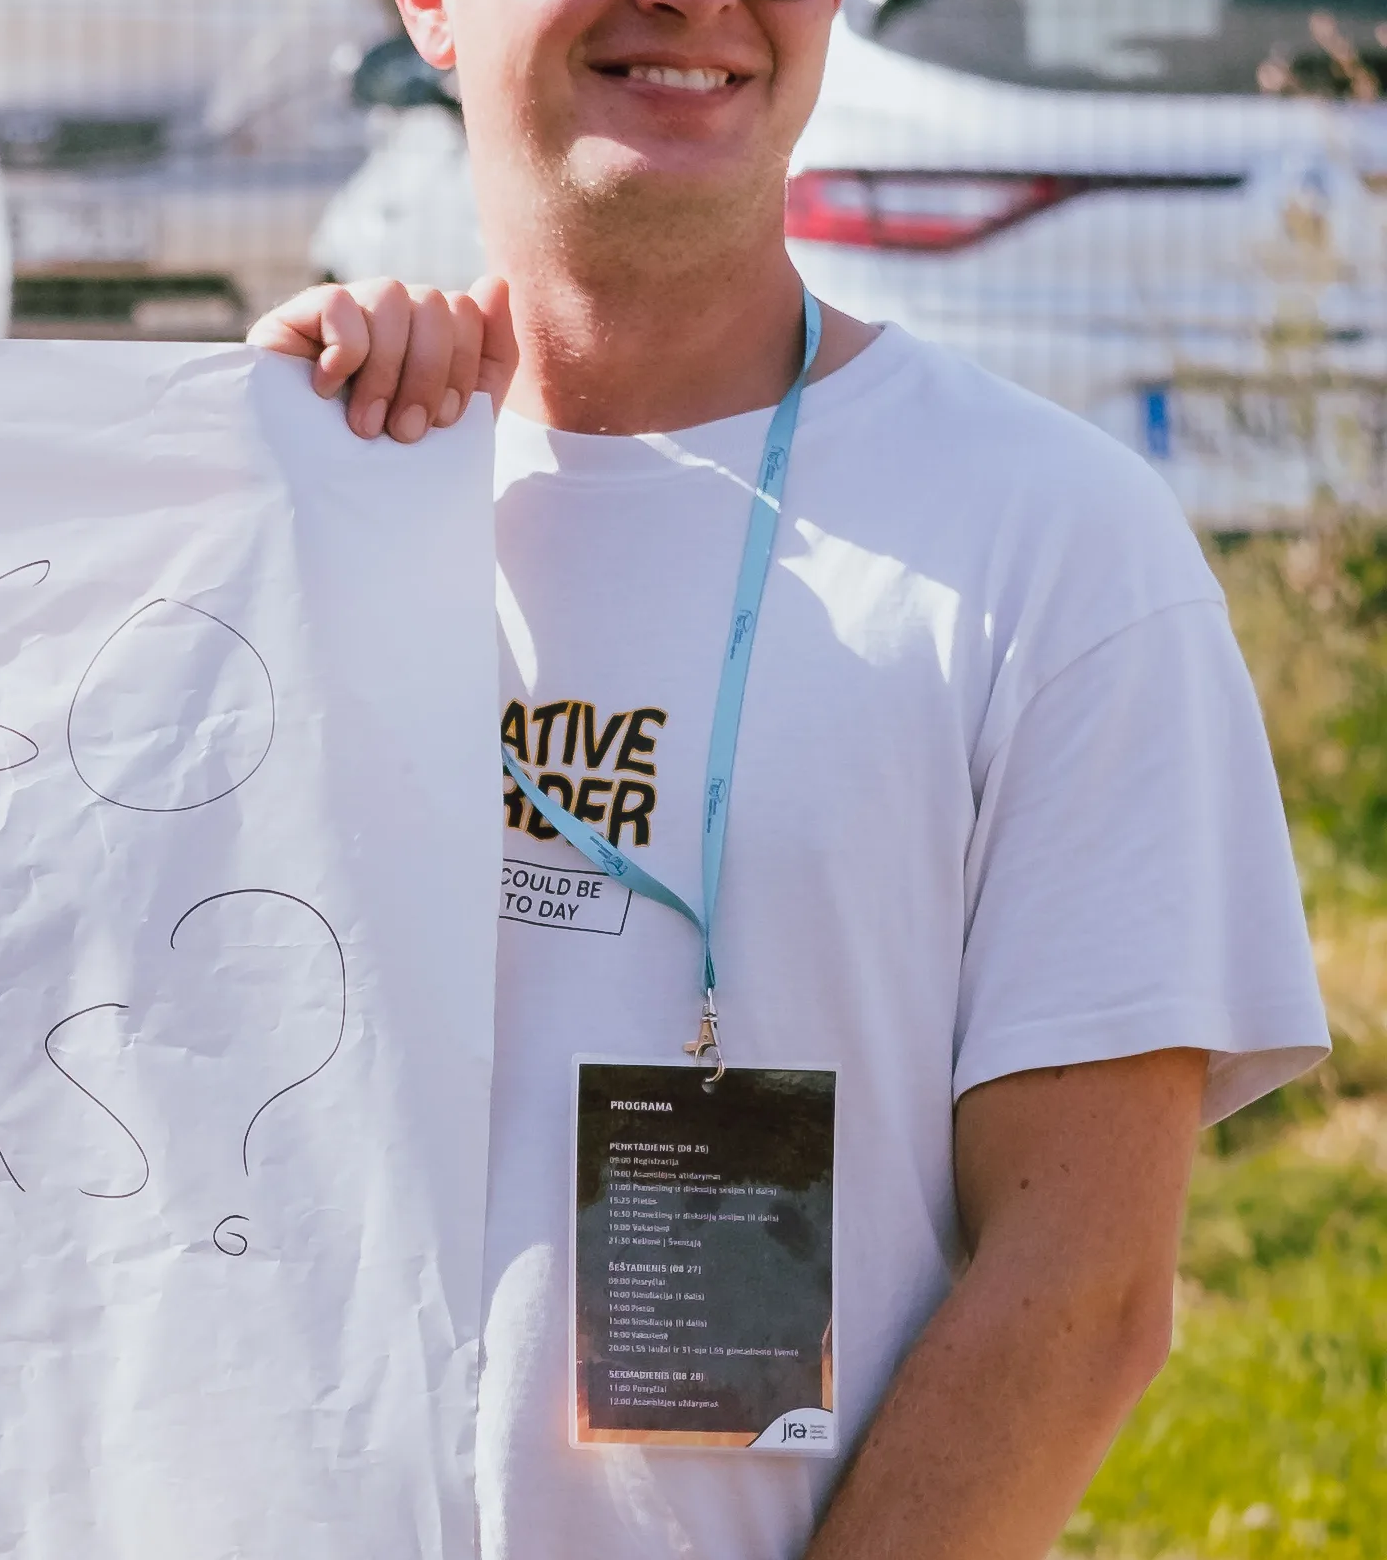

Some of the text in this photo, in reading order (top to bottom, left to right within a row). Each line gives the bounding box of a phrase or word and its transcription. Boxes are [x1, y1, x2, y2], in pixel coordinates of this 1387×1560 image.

[500, 697, 669, 776] ATIVE
[501, 867, 603, 899] COULD BE
[505, 892, 579, 921] TO DAY
[610, 1100, 673, 1111] PROGRAMA
[609, 1142, 675, 1152] PENKTADIENIS
[780, 1417, 807, 1443] jra
